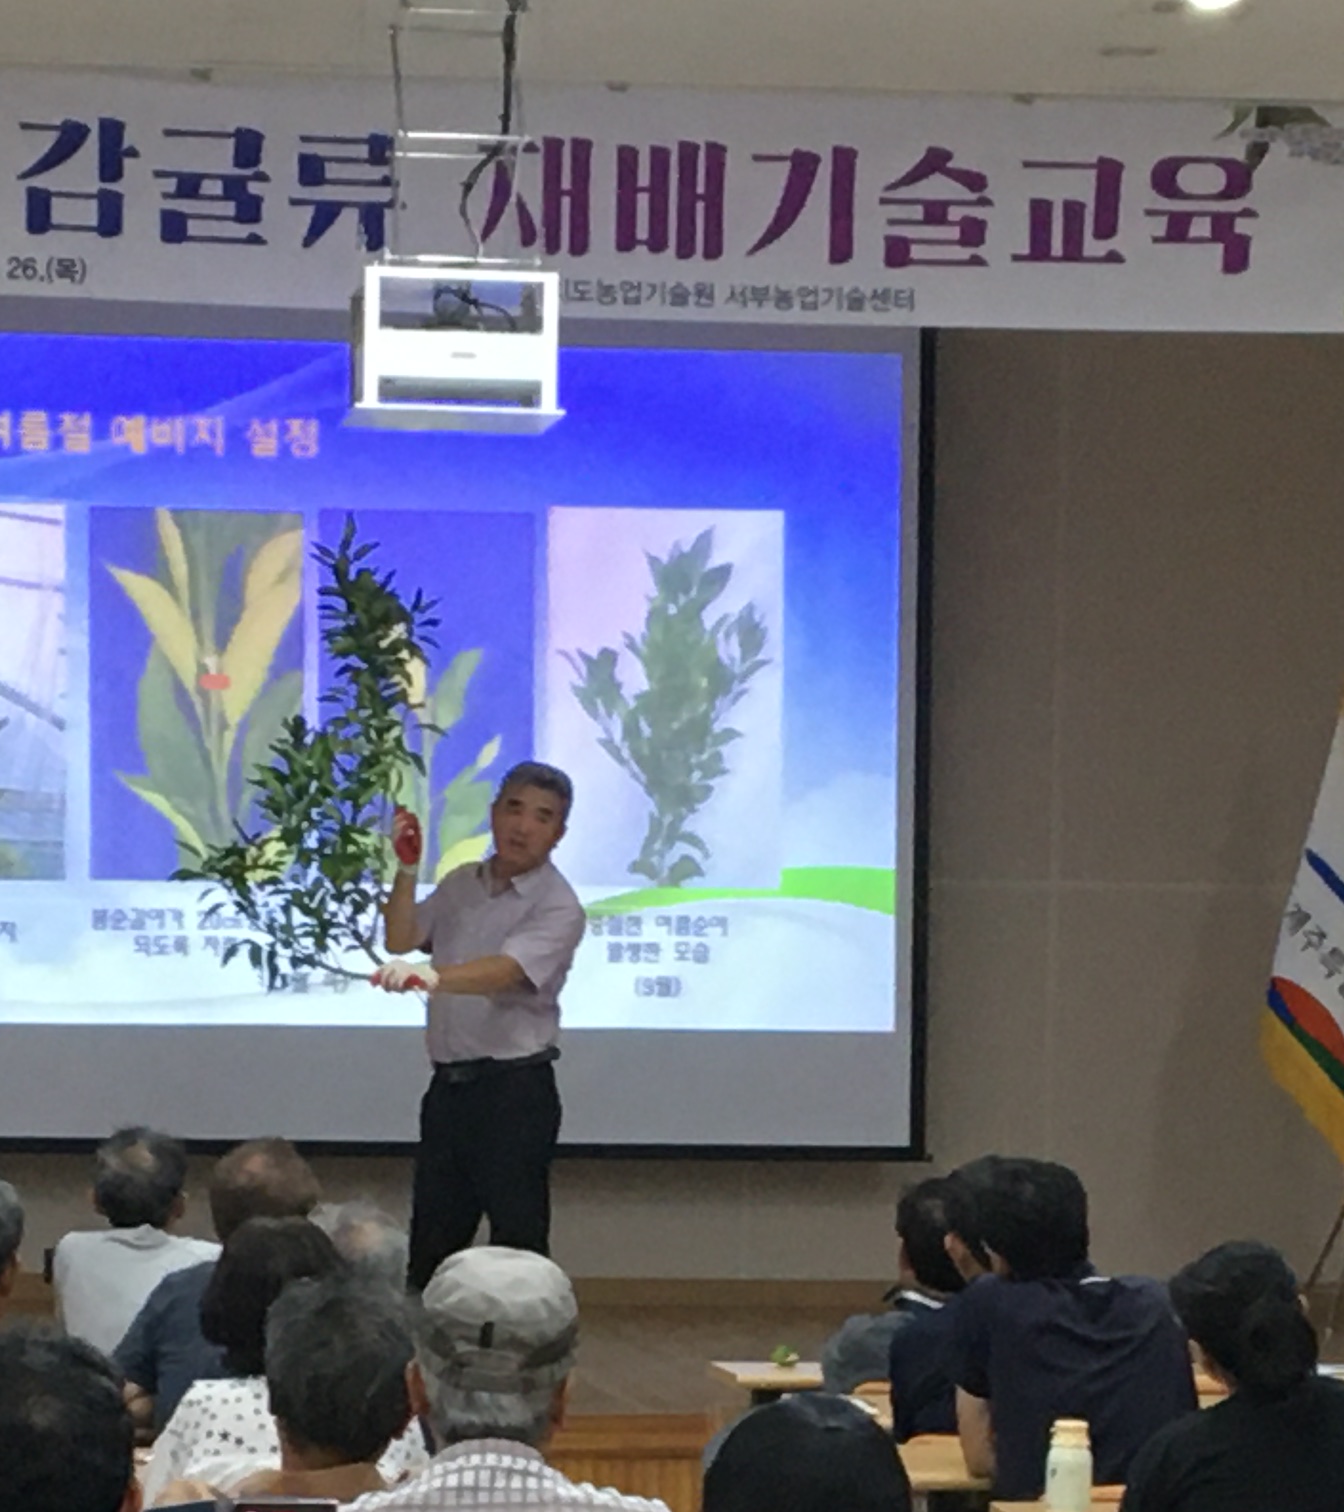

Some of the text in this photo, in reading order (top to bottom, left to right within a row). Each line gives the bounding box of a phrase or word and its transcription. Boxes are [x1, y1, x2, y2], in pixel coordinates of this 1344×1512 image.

[16, 116, 402, 252] 감귤류
[474, 135, 1261, 275] 재배기술교육
[6, 255, 88, 284] 26.(목)
